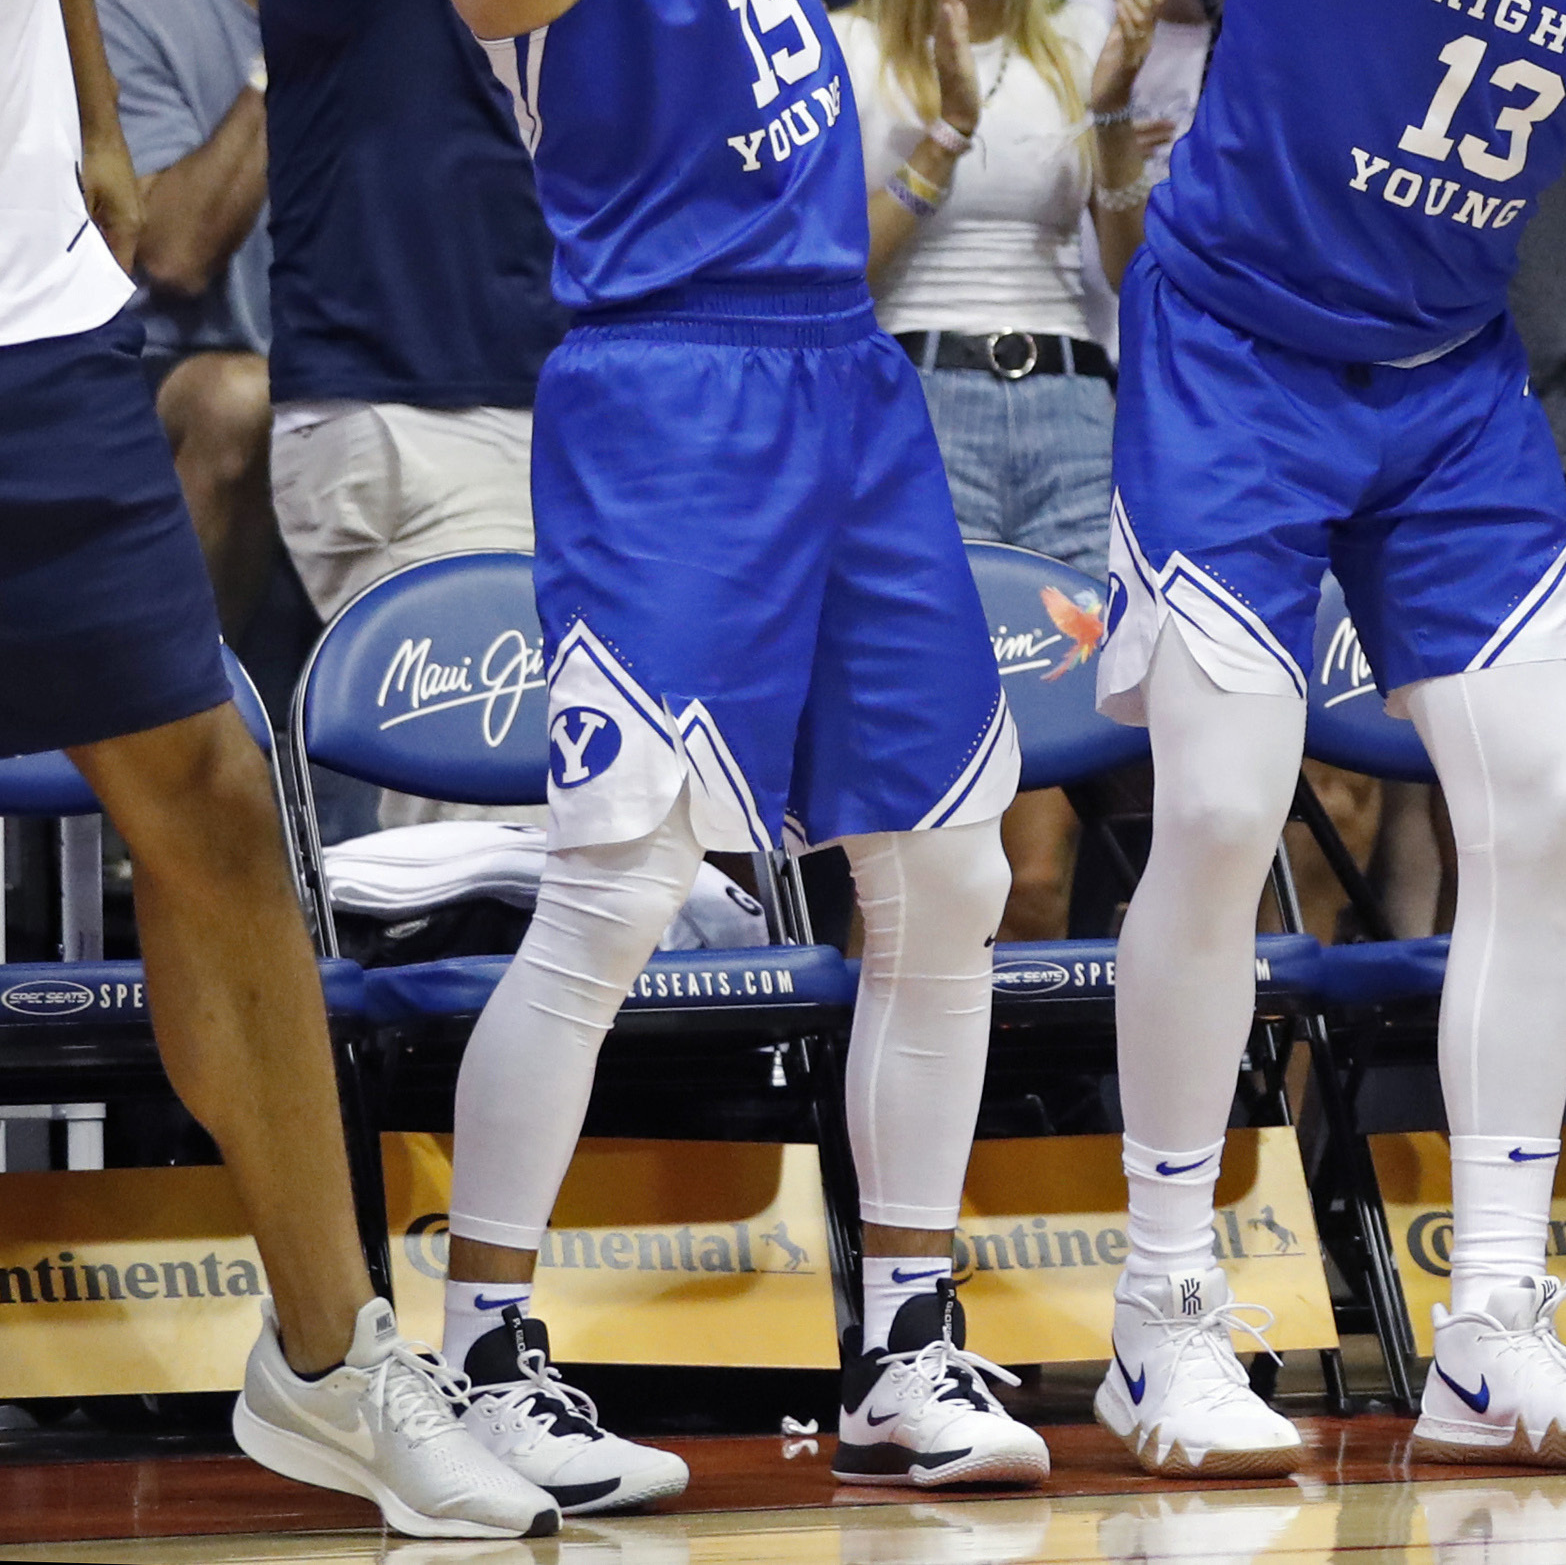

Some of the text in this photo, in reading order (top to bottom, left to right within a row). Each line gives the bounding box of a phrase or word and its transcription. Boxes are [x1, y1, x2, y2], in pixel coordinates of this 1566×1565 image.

[1398, 35, 1566, 182] 13
[1349, 147, 1526, 229] YOUNG
[991, 625, 1062, 660] im
[378, 629, 545, 748] Maui Ji
[550, 710, 608, 784] Y
[627, 969, 794, 999] CSEATS.COM
[0, 1250, 265, 1306] ntinenta
